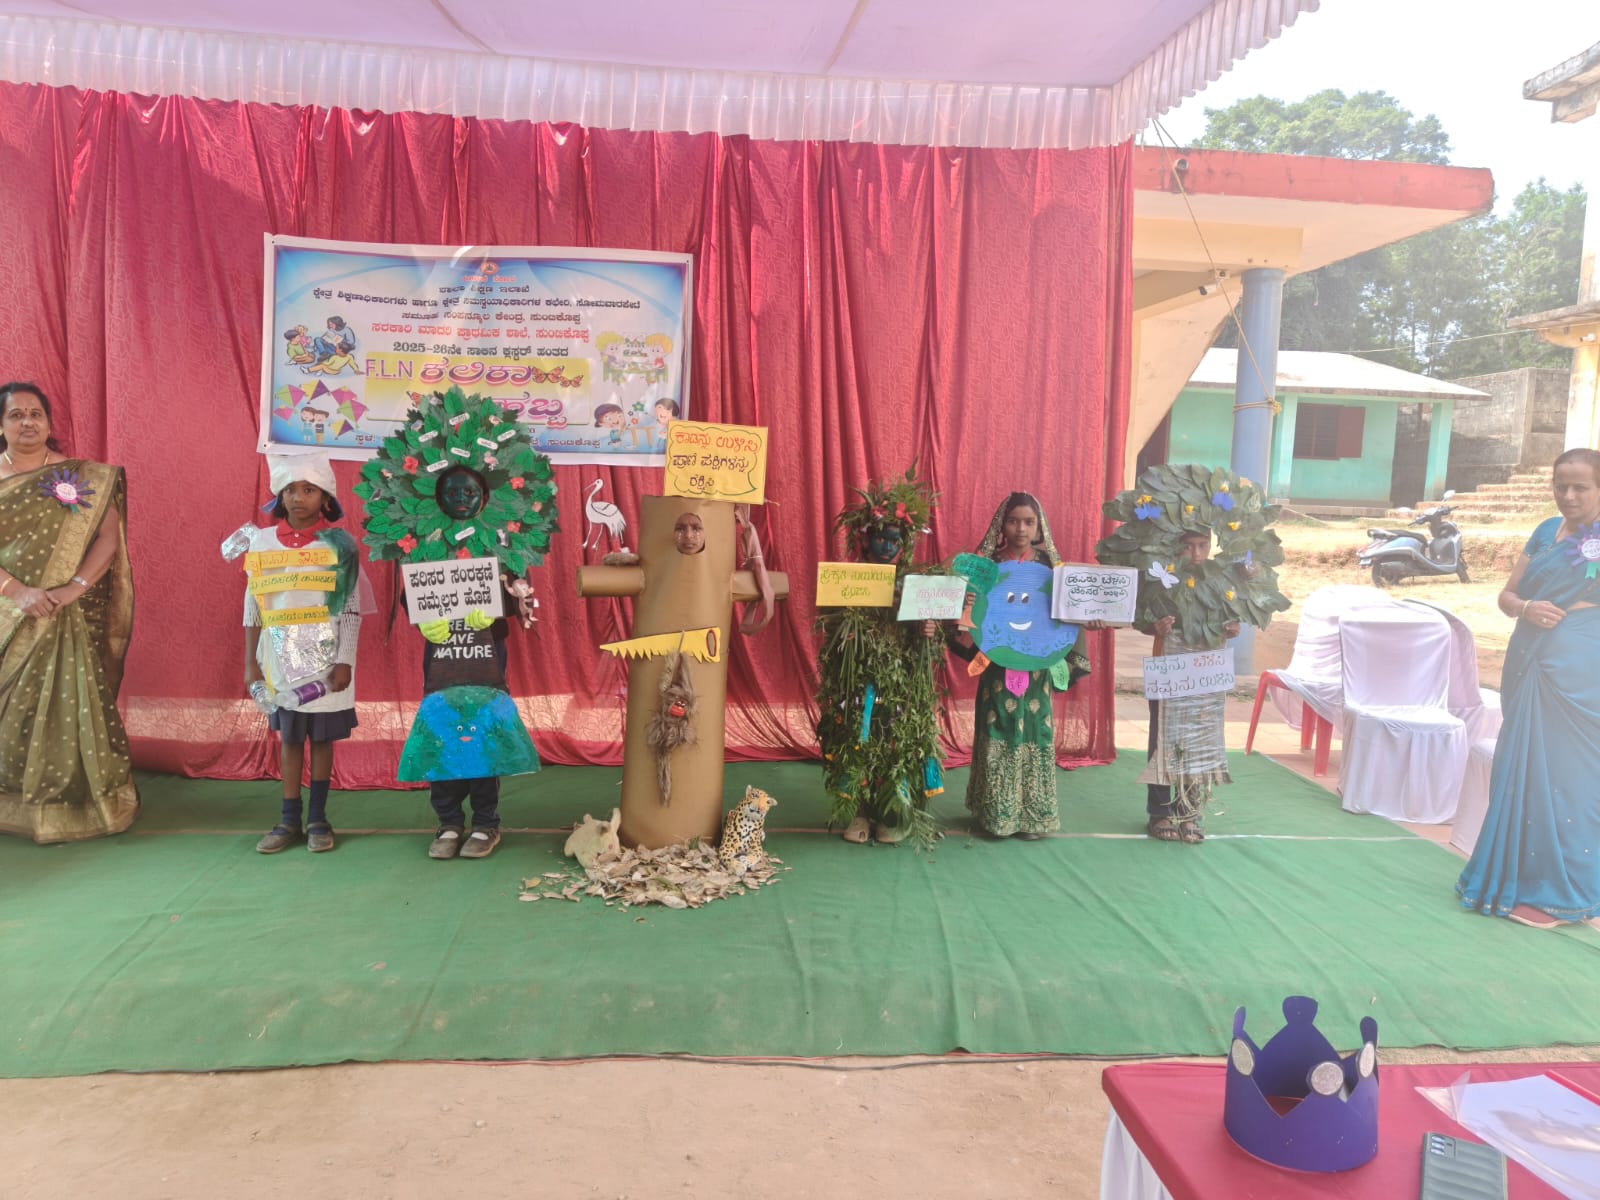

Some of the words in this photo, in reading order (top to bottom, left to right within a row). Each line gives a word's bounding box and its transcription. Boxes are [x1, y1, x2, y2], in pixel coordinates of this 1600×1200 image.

[313, 287, 333, 300] ಕ್ಷೇತ್ರ
[457, 325, 500, 341] ಪ್ರಾಥಮಿಕ
[393, 341, 461, 355] 2025-26ನೇ
[502, 345, 532, 360] ಕ್ಲಸ್ಟರ್
[536, 346, 569, 356] ಹಂತದ
[365, 358, 413, 379] F.L.N
[420, 357, 534, 387] ಕಲಿಕಾ
[715, 435, 758, 453] ಉಳಿಸಿ
[672, 452, 697, 469] ಪ್ರಾಣಿ
[409, 566, 445, 588] ಪರಿಸರ
[450, 562, 494, 589] ಸಂರಕ್ಷಣೆ
[417, 589, 459, 617] ನಮ್ಮೆಲ್ಲರ
[464, 586, 492, 605] ಹೊಣೆ
[433, 645, 493, 660] NATURE
